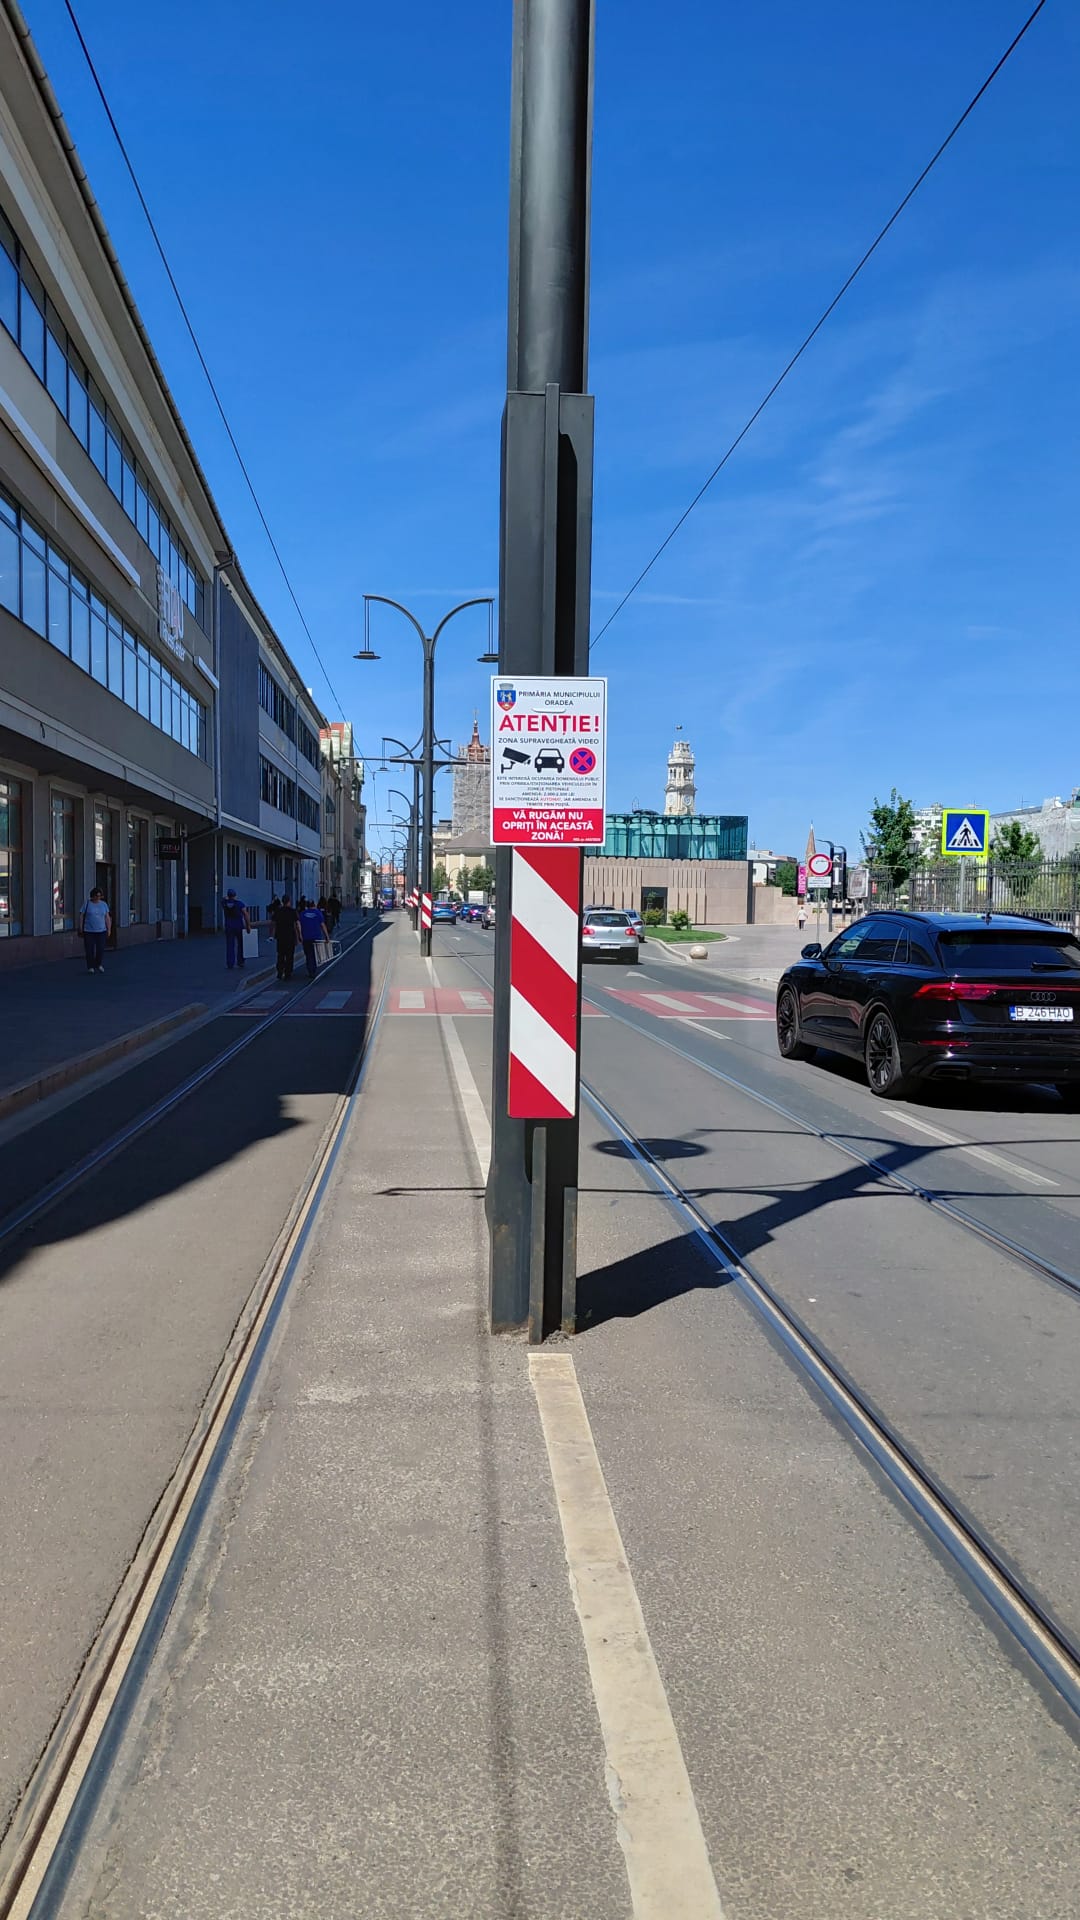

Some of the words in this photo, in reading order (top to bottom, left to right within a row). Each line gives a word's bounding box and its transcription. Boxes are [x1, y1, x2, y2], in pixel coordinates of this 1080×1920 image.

[518, 690, 552, 698] PRIMĂRIA
[499, 714, 599, 735] ATENȚIE!
[512, 810, 526, 820] VĂ
[529, 810, 566, 820] RUGĂM
[568, 811, 584, 820] NU
[502, 821, 534, 832] OPRIȚI
[536, 820, 548, 830] ÎN
[550, 821, 594, 830] ACEASTĂ
[531, 830, 564, 840] ZONĂ!
[1016, 1006, 1024, 1017] B
[1028, 1007, 1047, 1018] 246
[1048, 1007, 1070, 1018] HAO
